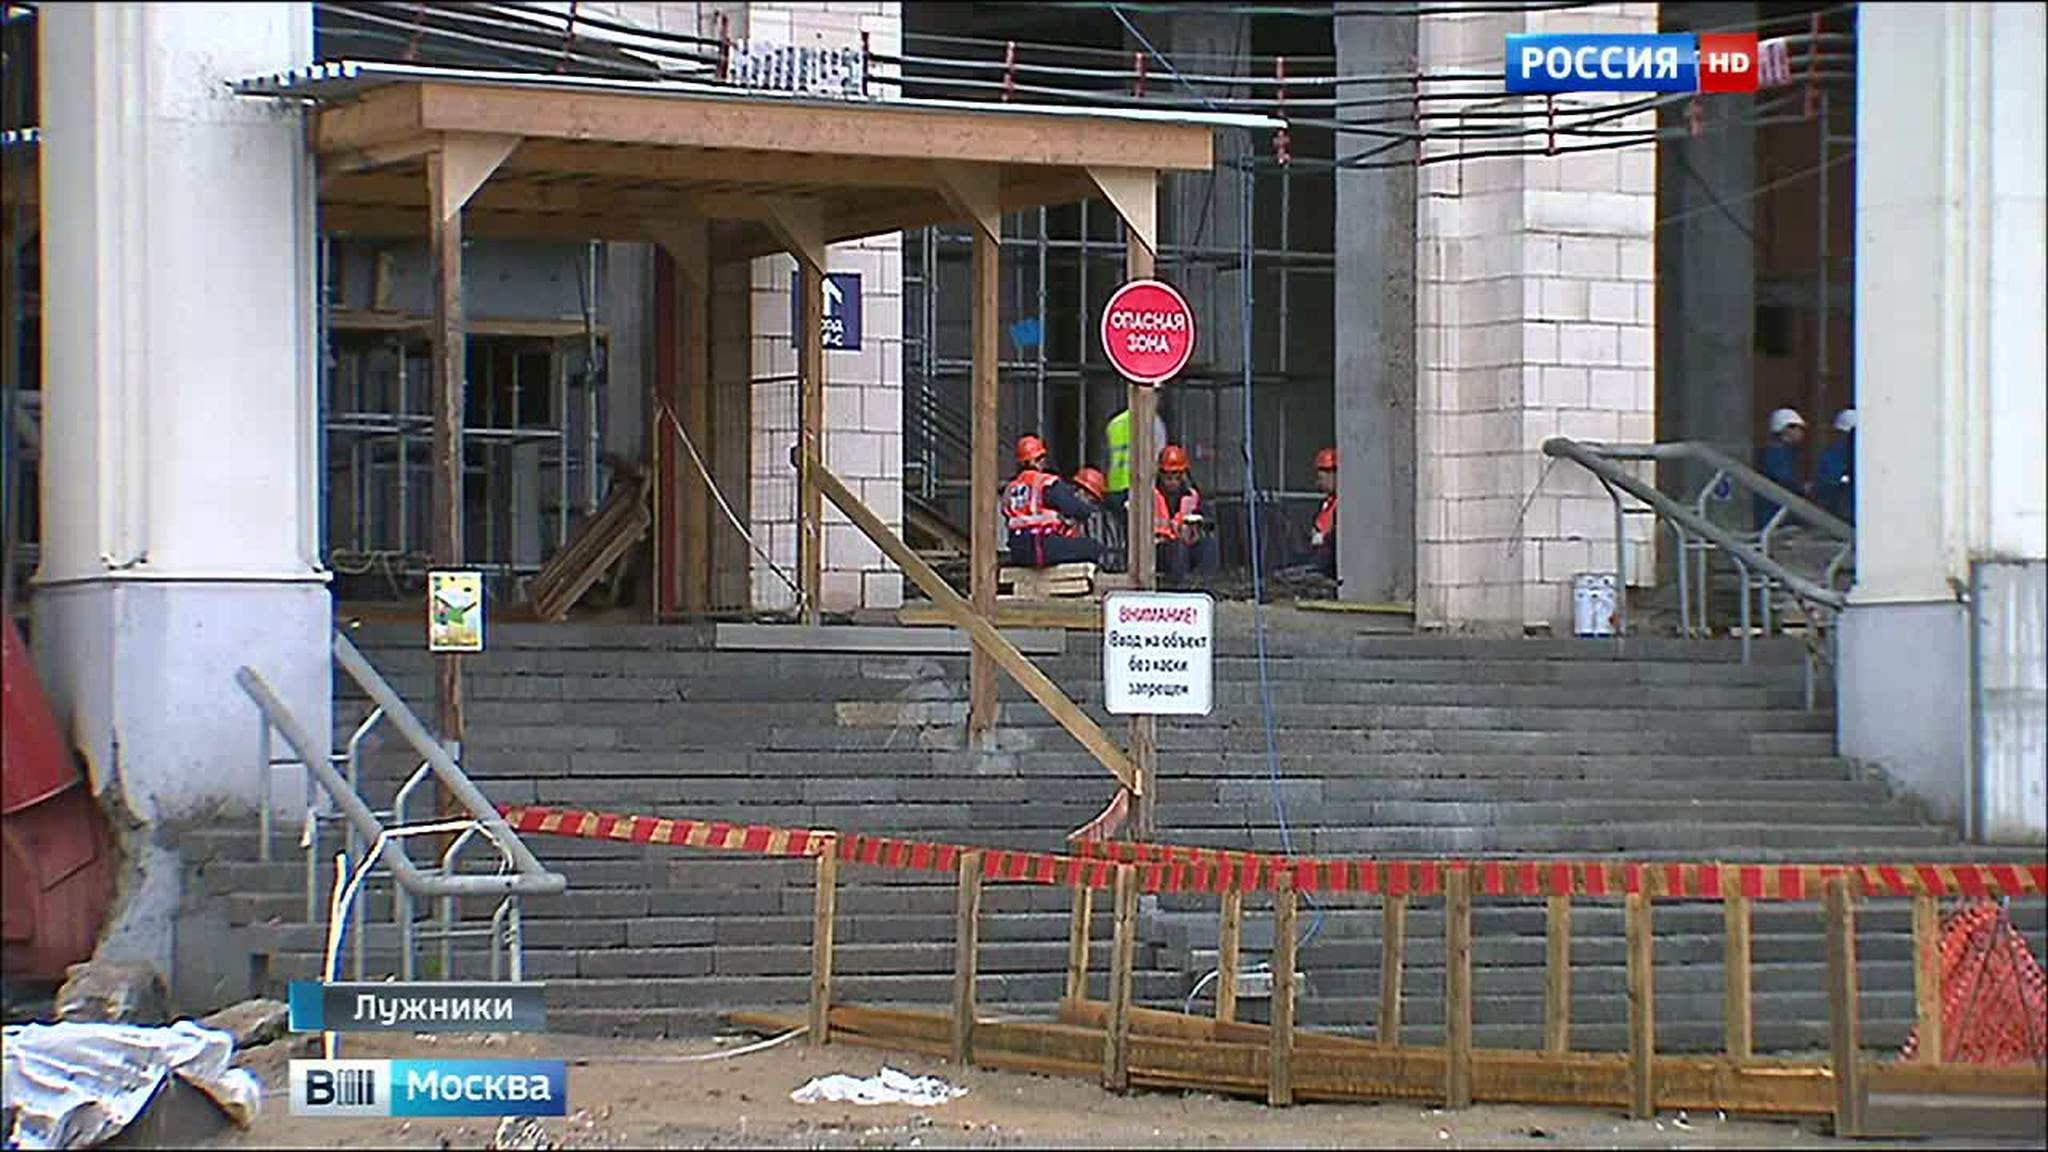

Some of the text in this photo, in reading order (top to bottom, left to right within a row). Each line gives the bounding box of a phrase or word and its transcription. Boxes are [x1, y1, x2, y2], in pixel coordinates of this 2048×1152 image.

[1110, 310, 1186, 331] ОПАСНАЯ
[1126, 332, 1170, 353] ЗОНА
[1118, 606, 1197, 625] ВНИМАНИЕ!
[1108, 630, 1207, 649] Вход на объект
[1127, 655, 1189, 673] без каски
